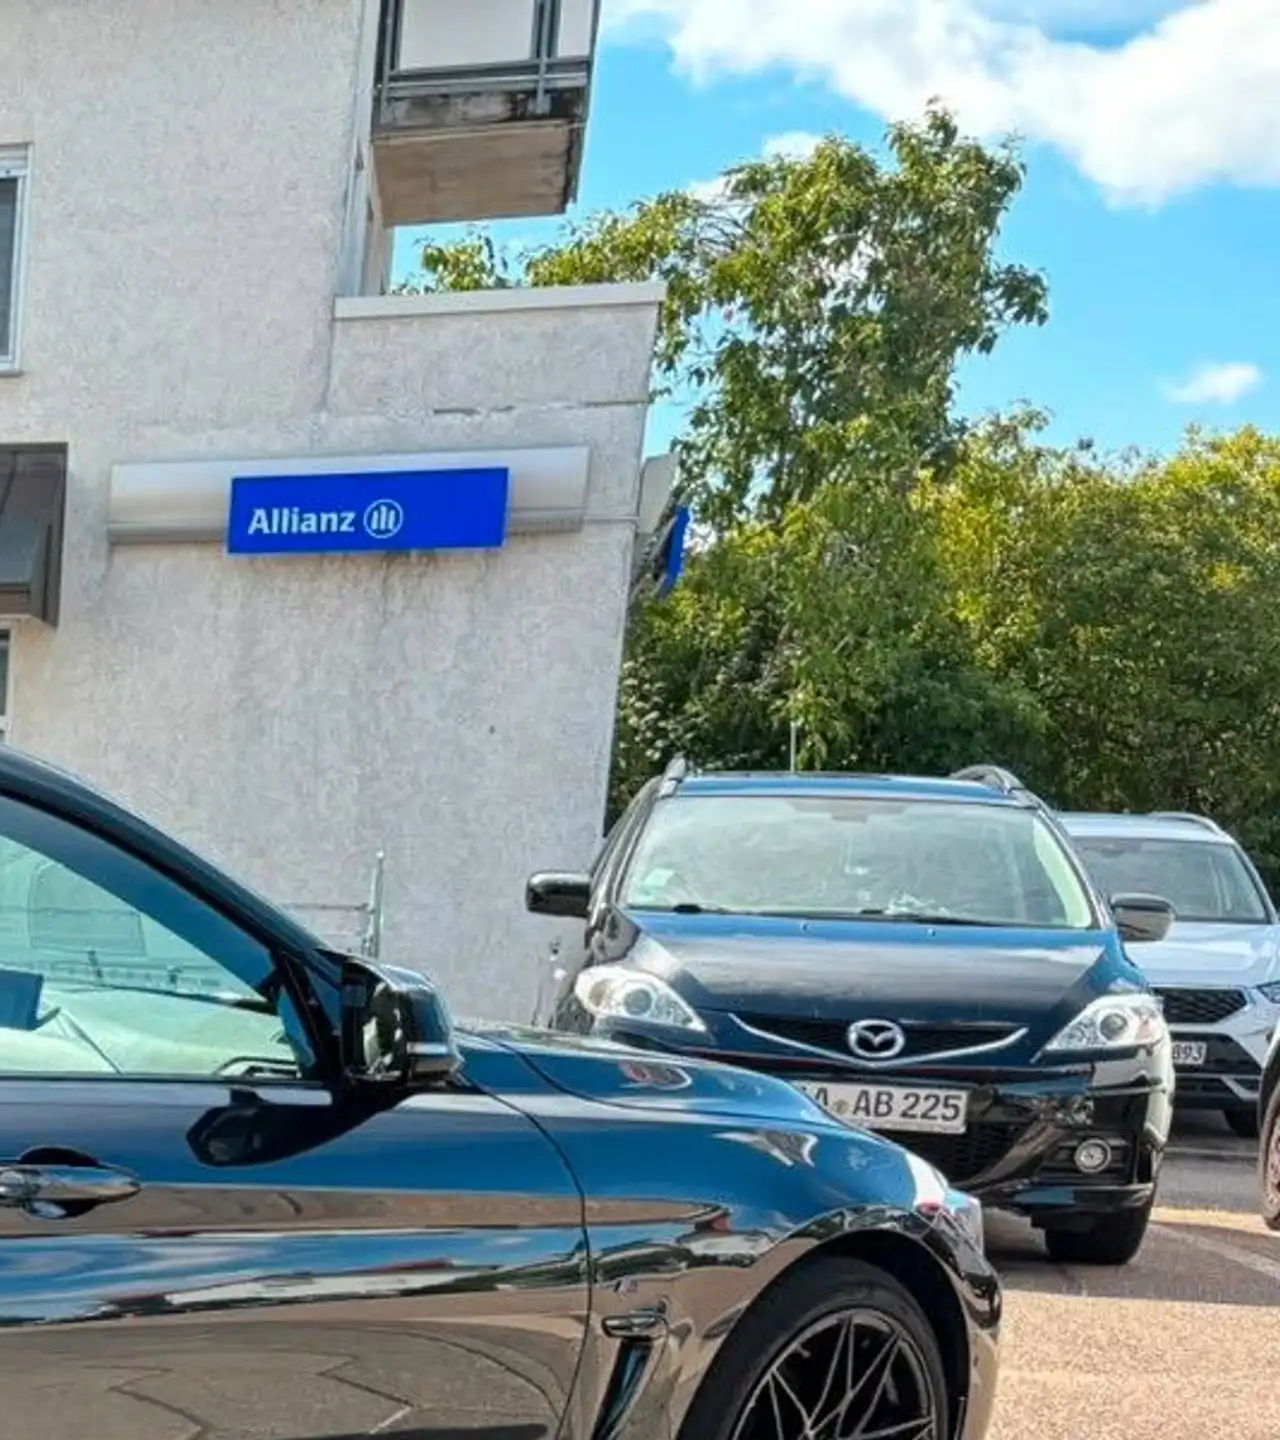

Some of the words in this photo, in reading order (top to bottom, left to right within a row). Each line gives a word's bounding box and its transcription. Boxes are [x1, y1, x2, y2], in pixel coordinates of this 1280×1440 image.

[246, 506, 356, 535] Allianz
[852, 1089, 895, 1118] AB
[899, 1091, 963, 1122] 225
